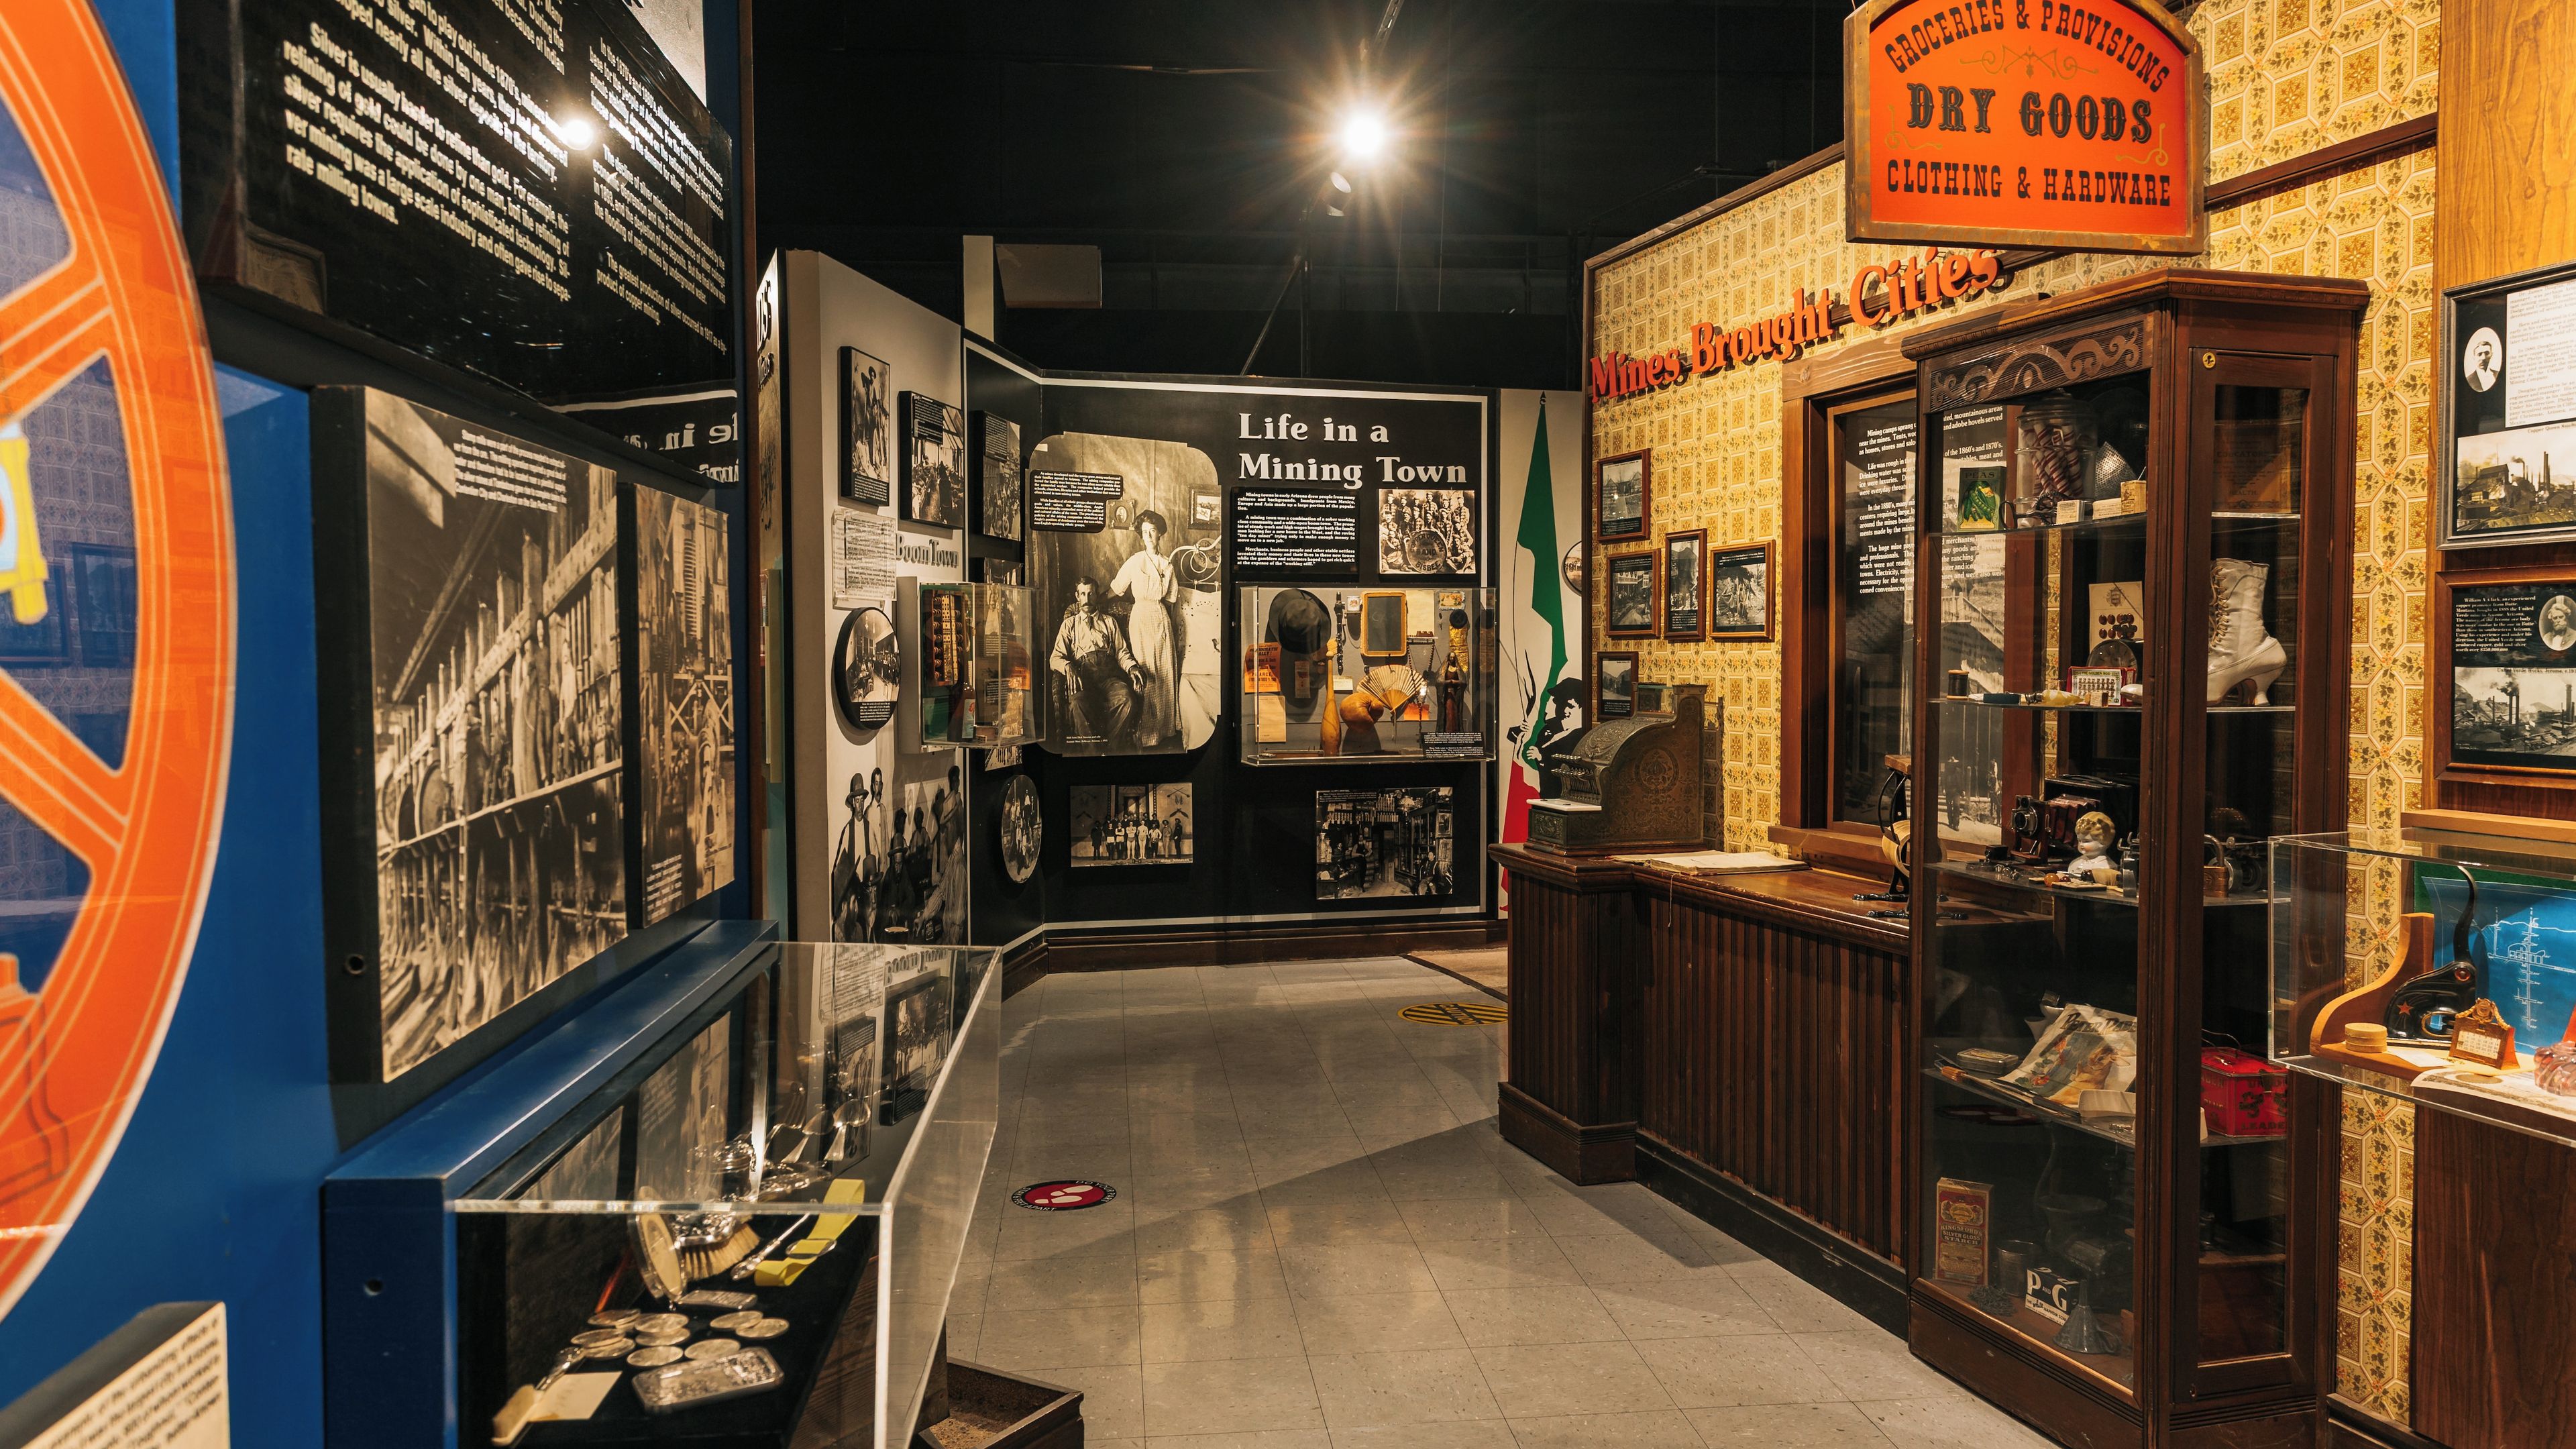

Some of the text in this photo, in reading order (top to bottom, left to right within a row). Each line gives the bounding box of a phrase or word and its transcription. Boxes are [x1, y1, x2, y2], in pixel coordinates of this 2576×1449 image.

[1884, 0, 2170, 93] GROCERIES & PROVISIONS
[310, 21, 347, 67] Silver
[347, 50, 360, 77] is
[360, 65, 400, 111] usually
[434, 117, 445, 141] to
[471, 146, 490, 175] than
[491, 164, 511, 191] gold.
[513, 176, 526, 201] For
[527, 191, 557, 228] example,
[557, 213, 568, 233] the
[1907, 83, 2152, 144] DRY GOODS
[283, 40, 569, 257] refining of gold could be done by one man, but the refining of
[284, 74, 570, 278] silver requires the application of sophisticated technology. Sil-
[286, 144, 398, 225] rate milling towns.
[1888, 159, 2171, 206] CLOTHING & HARDWARE
[284, 109, 571, 301] ver mining was a large scale industry and often gave rise to sepa-
[1590, 247, 1998, 402] Mines Brought Cities
[1238, 413, 1389, 443] Life in a
[1951, 413, 2002, 429] adobe hovels served
[1953, 409, 1988, 419] mountainous
[1867, 429, 1882, 437] Mining
[1897, 423, 1913, 431] sprang
[1896, 440, 1904, 448] and
[1885, 458, 1898, 467] rough
[1943, 449, 1949, 458] of
[1959, 445, 1975, 454] 1860's
[1975, 443, 1985, 451] and
[1985, 441, 2002, 449] 1870's.
[1978, 449, 2002, 462] meat and
[1238, 453, 1466, 490] Mining Town
[1965, 471, 1995, 479] PEAS
[1416, 561, 1442, 571] BISBEE
[2241, 1122, 2286, 1130] LEADE
[1945, 1236, 1978, 1245] STARCH
[2027, 1269, 2067, 1311] P AND G
